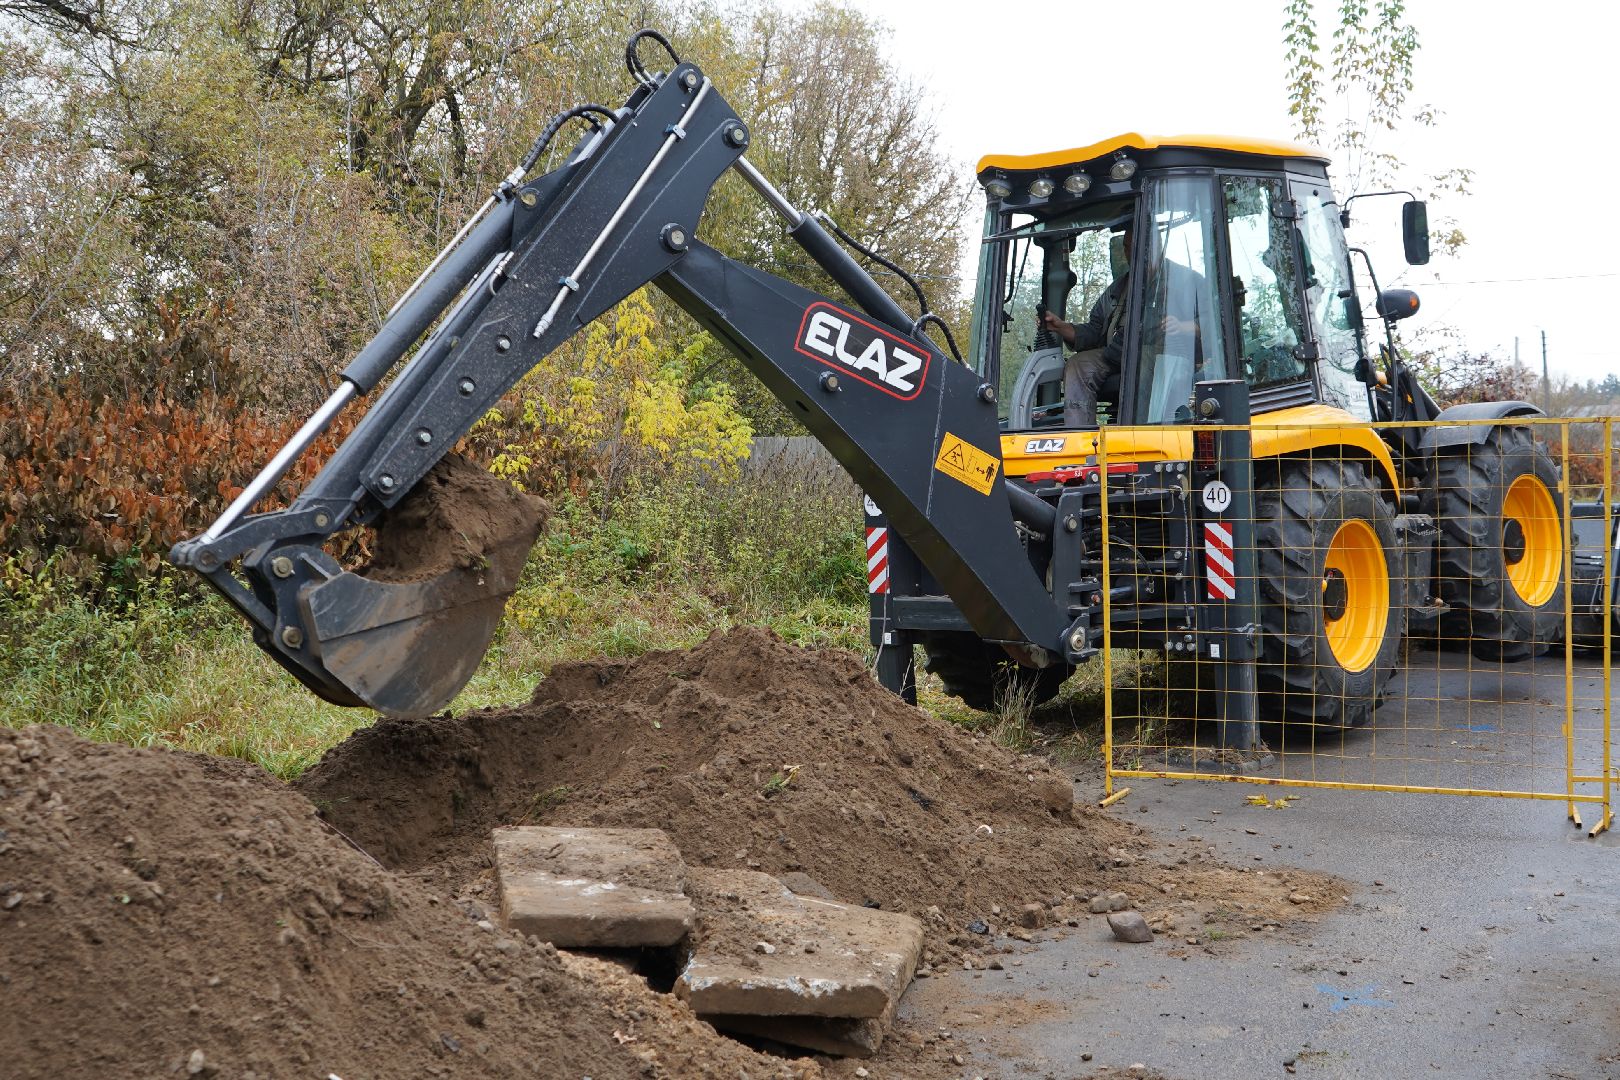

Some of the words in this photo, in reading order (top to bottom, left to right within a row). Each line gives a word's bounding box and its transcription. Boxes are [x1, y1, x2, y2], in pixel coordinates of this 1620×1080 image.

[805, 311, 921, 391] ELAZ
[1026, 439, 1064, 452] ELAZ
[1206, 487, 1227, 504] 40
